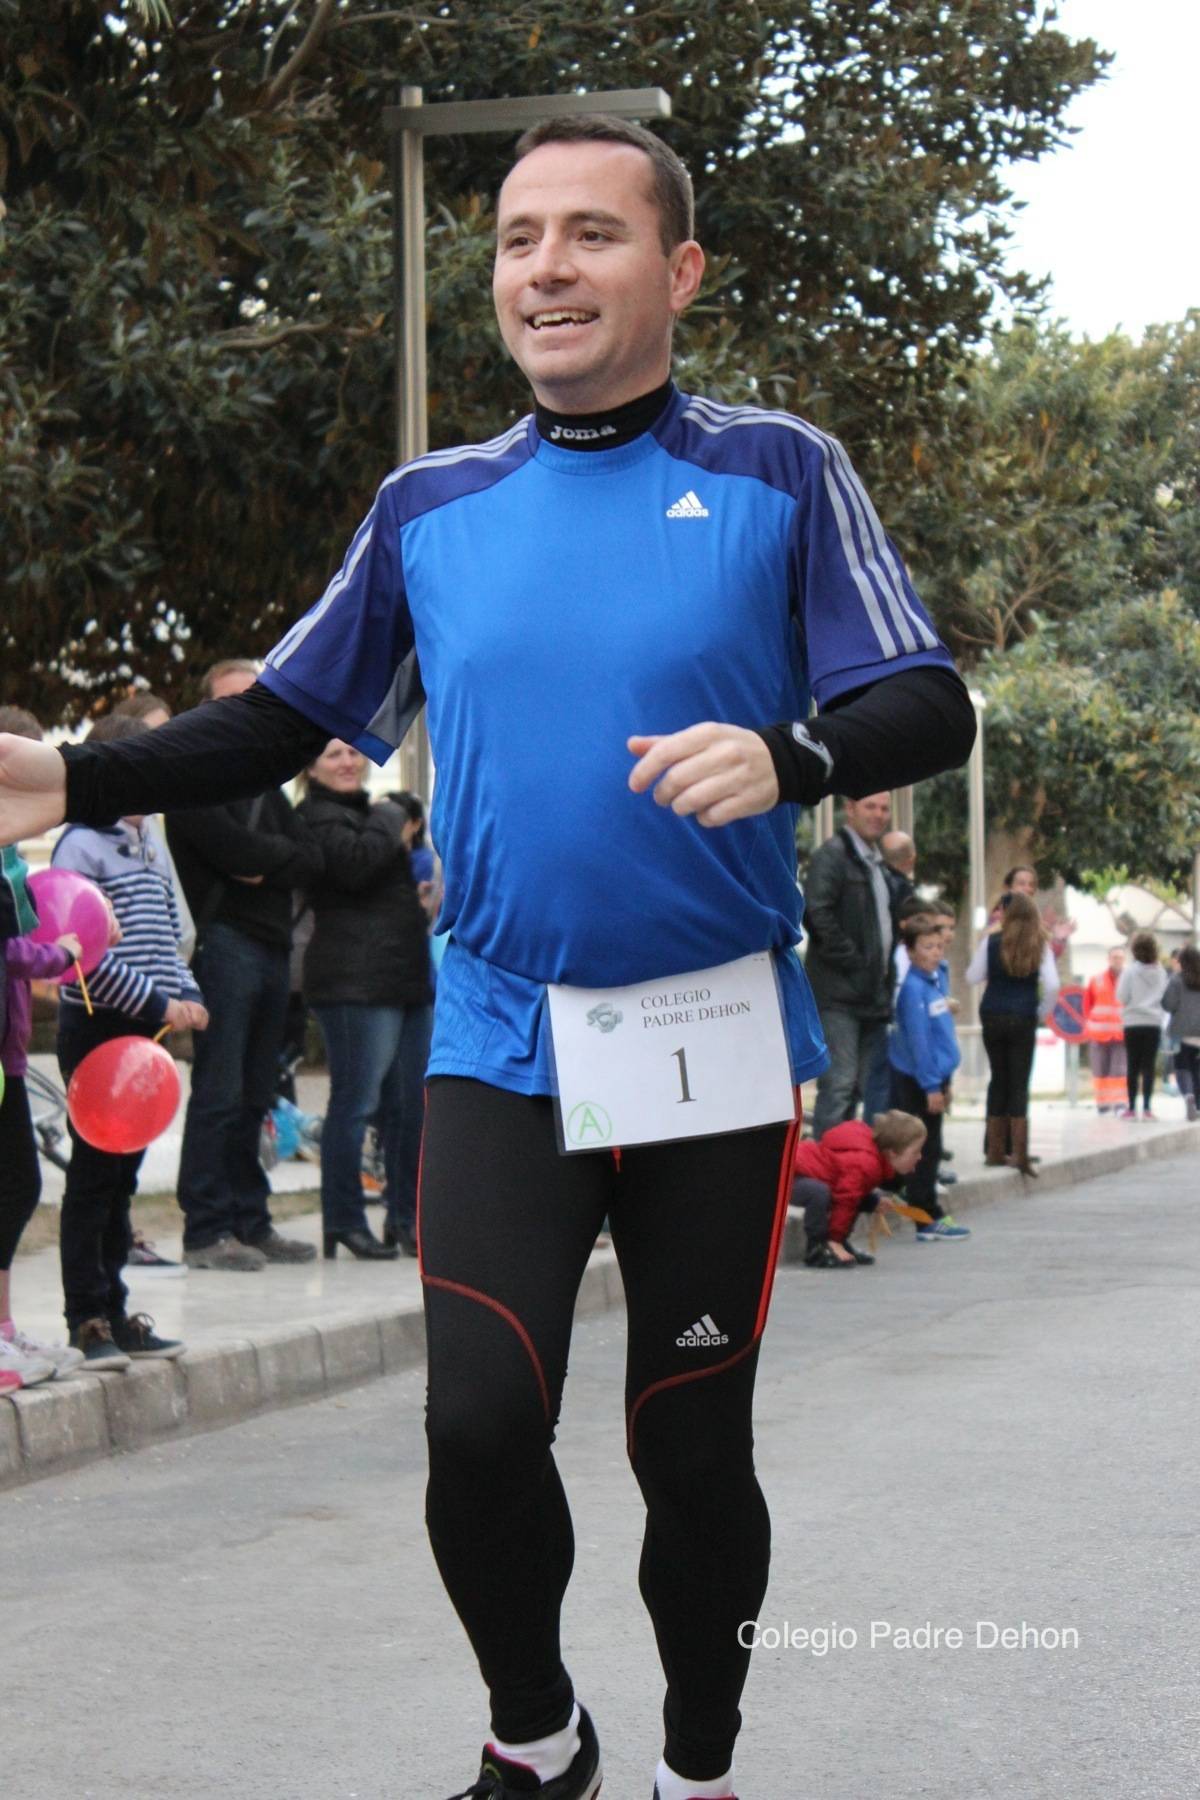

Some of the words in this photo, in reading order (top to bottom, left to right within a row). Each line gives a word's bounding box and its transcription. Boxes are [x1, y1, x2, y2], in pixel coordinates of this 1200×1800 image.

[666, 507, 709, 518] adidas
[640, 988, 711, 1010] COLEGIO
[642, 1010, 695, 1029] PADRE
[698, 1001, 751, 1021] DEHON
[670, 1047, 697, 1104] 1
[578, 1107, 604, 1141] A
[675, 1334, 729, 1347] adidas
